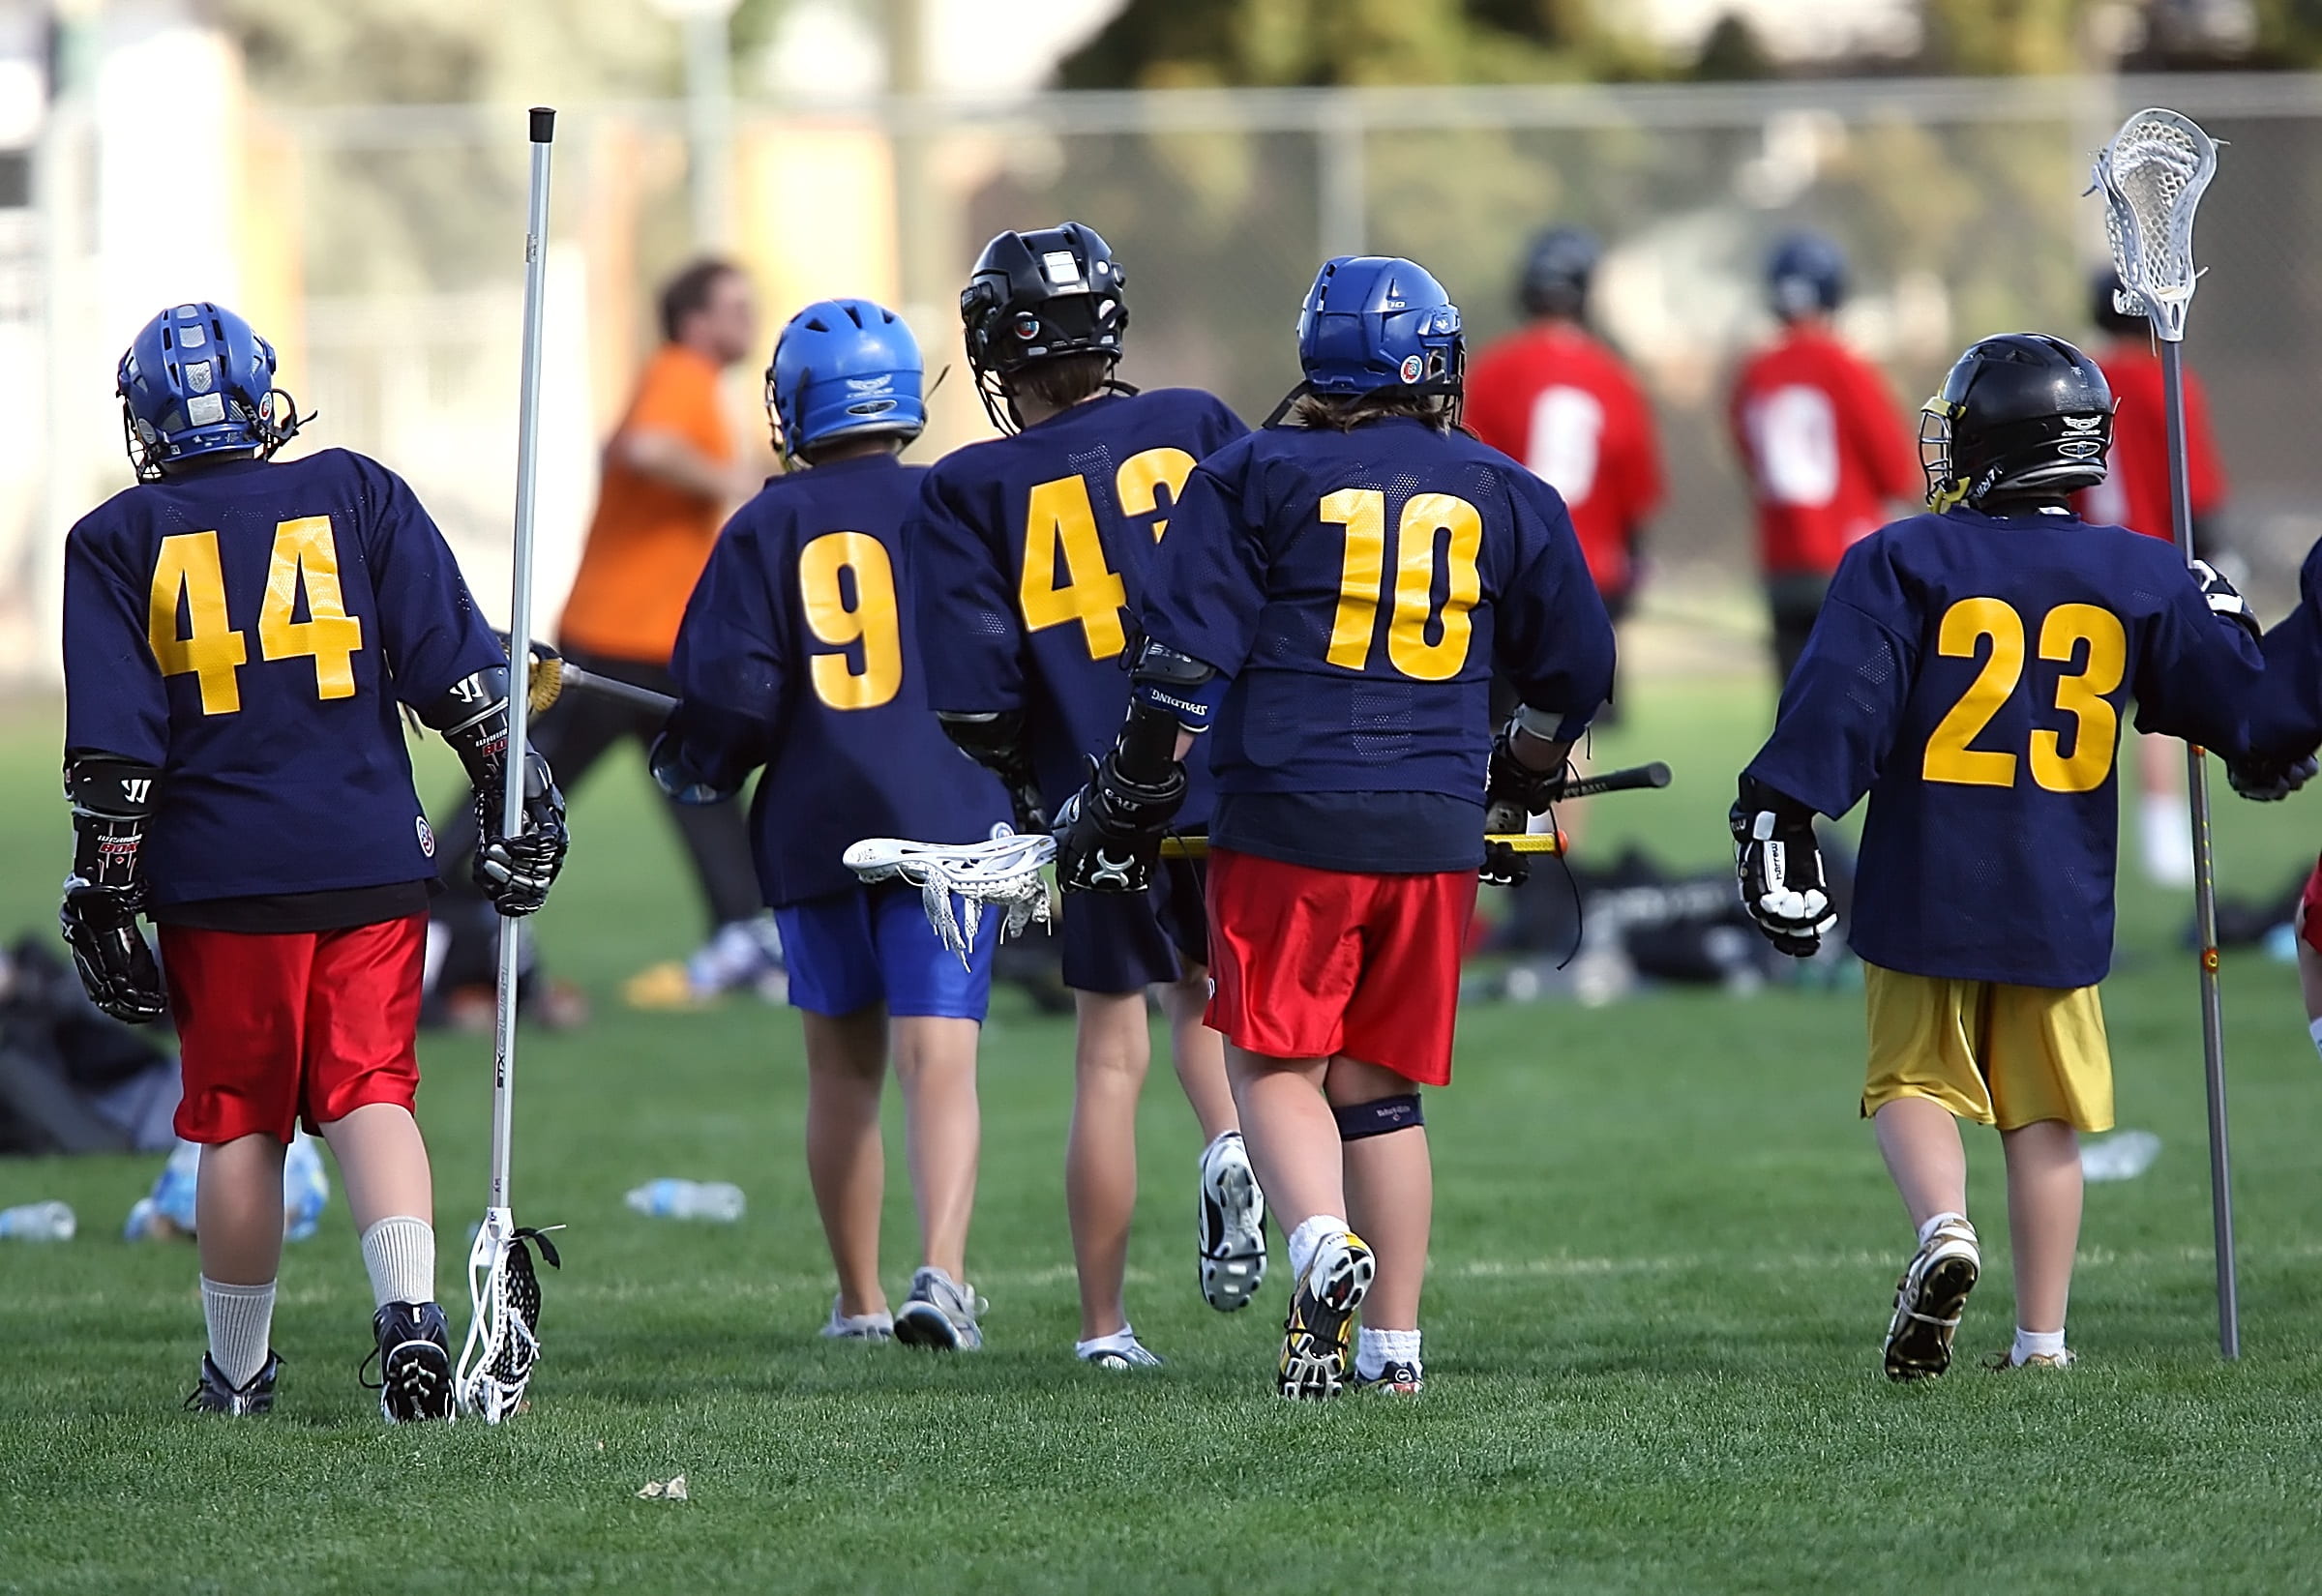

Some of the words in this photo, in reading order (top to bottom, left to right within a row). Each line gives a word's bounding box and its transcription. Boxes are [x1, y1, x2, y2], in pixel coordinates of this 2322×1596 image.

[148, 515, 363, 715] 44
[799, 531, 904, 711] 9
[1319, 488, 1483, 682] 10
[1150, 689, 1208, 716] SPALDING
[1921, 597, 2127, 793] 23
[496, 1051, 505, 1088] STX
